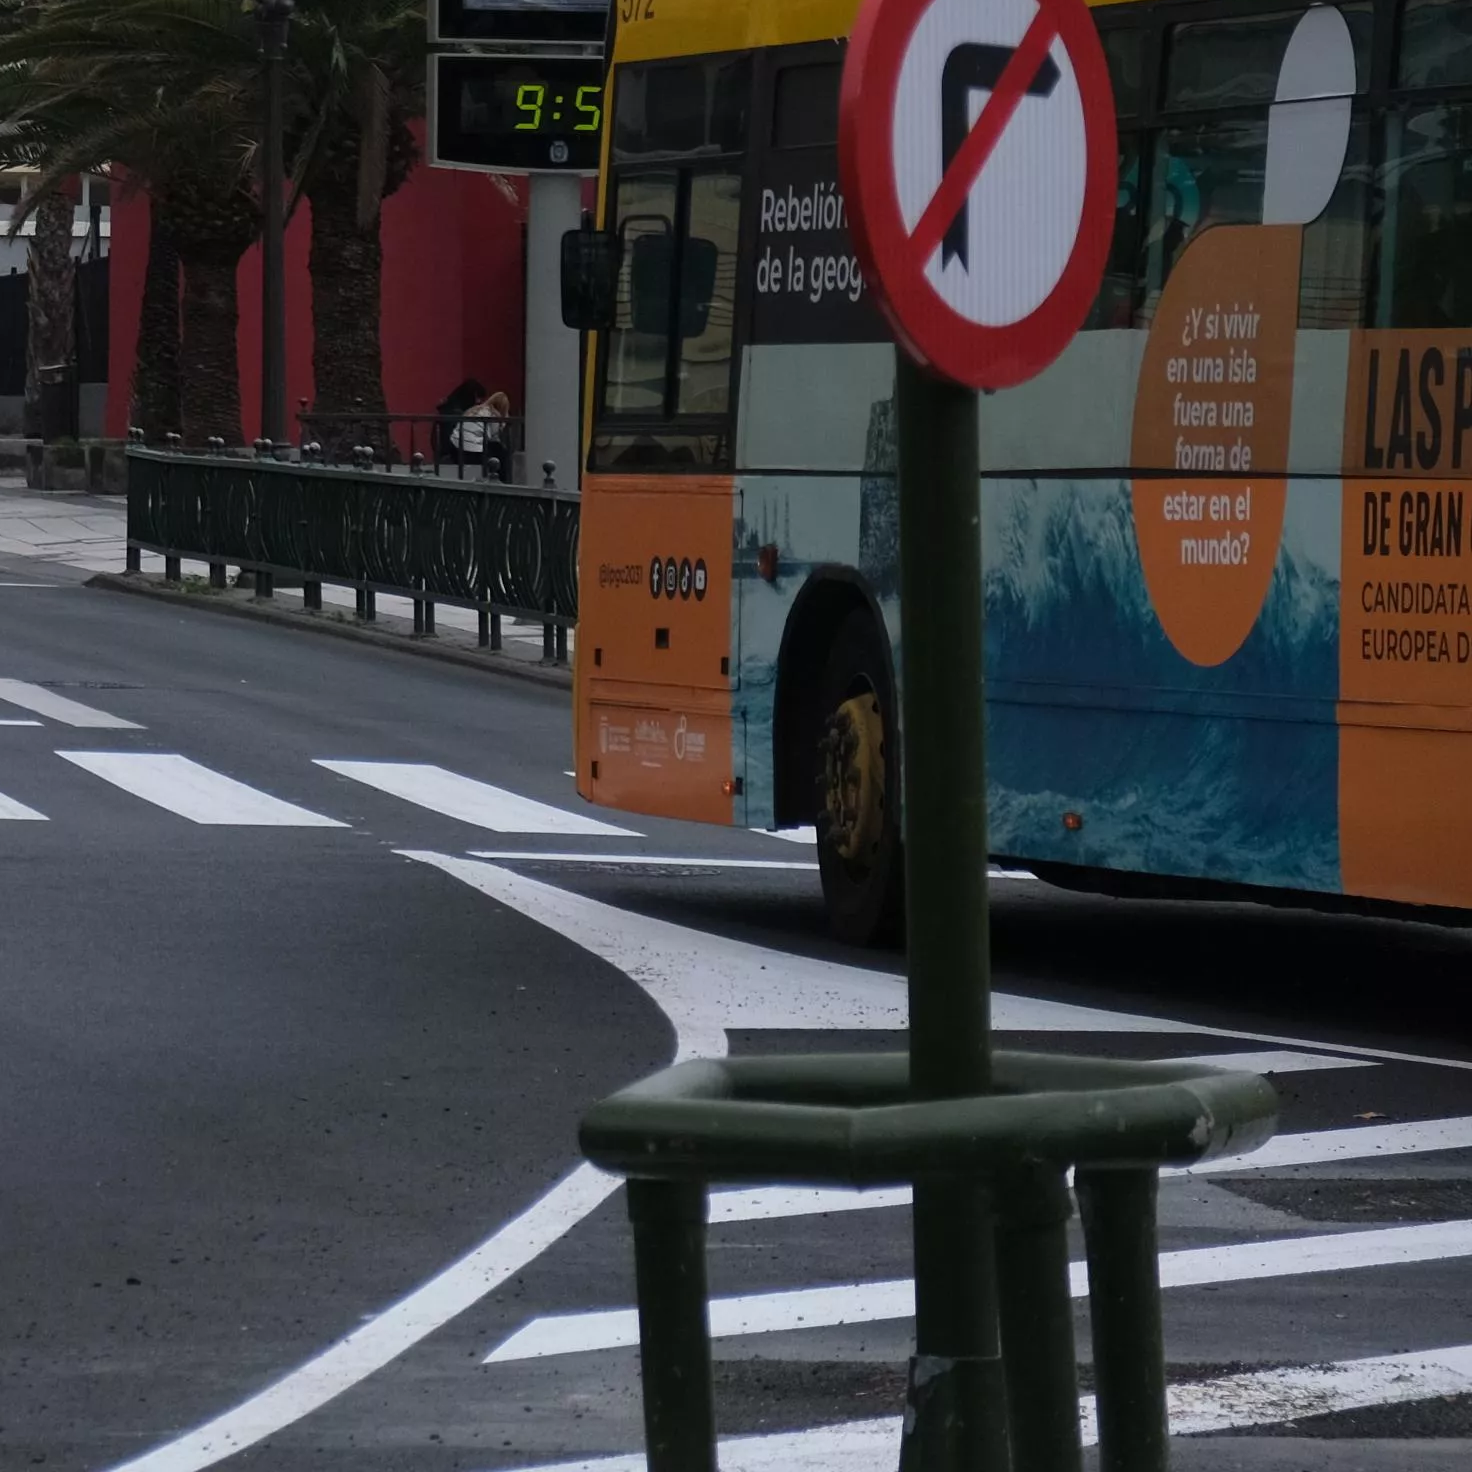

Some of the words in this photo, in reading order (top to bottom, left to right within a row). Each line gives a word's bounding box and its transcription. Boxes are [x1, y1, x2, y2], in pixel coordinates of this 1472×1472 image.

[514, 85, 602, 131] 9:5
[761, 182, 848, 232] Rebelión
[757, 246, 782, 293] de
[788, 245, 804, 292] la
[810, 255, 864, 303] geog
[1182, 307, 1203, 346] ¿Y
[1206, 303, 1220, 339] si
[1223, 303, 1261, 340] vivir
[1167, 357, 1188, 383] en
[1193, 357, 1224, 383] una
[1229, 347, 1256, 383] isla
[1173, 392, 1217, 427] fuera
[1222, 401, 1254, 427] una
[1364, 346, 1445, 470] LAS
[1175, 435, 1225, 470] forma
[1230, 436, 1251, 471] de
[1163, 490, 1205, 521] estar
[1209, 495, 1230, 521] en
[1236, 486, 1251, 521] el
[1363, 490, 1391, 557] DE
[1399, 490, 1464, 558] GRAN
[1181, 529, 1250, 565] mundo?
[1361, 581, 1471, 616] CANDIDATA
[1361, 628, 1450, 664] EUROPEA
[1456, 630, 1472, 664] D
